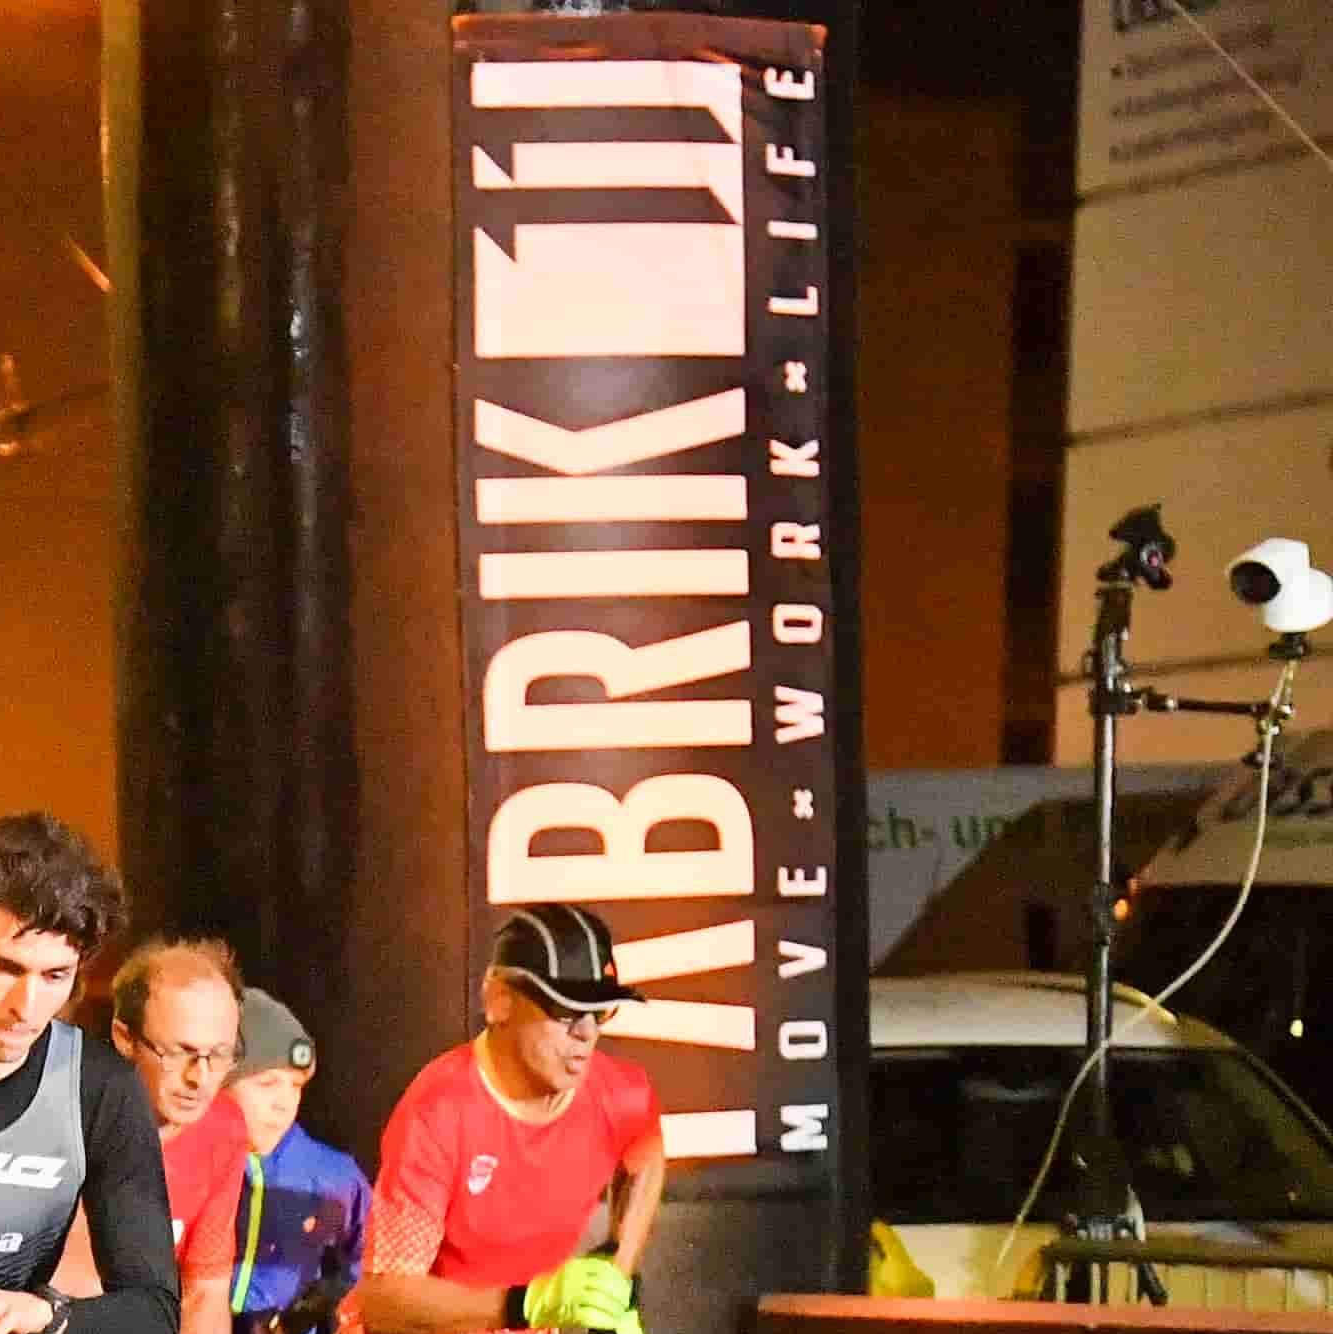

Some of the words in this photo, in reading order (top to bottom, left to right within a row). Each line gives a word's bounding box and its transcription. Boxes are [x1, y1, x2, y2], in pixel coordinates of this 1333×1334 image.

[763, 67, 819, 317] LIFE
[769, 438, 825, 745] WORK
[778, 865, 830, 1153] MOVE
